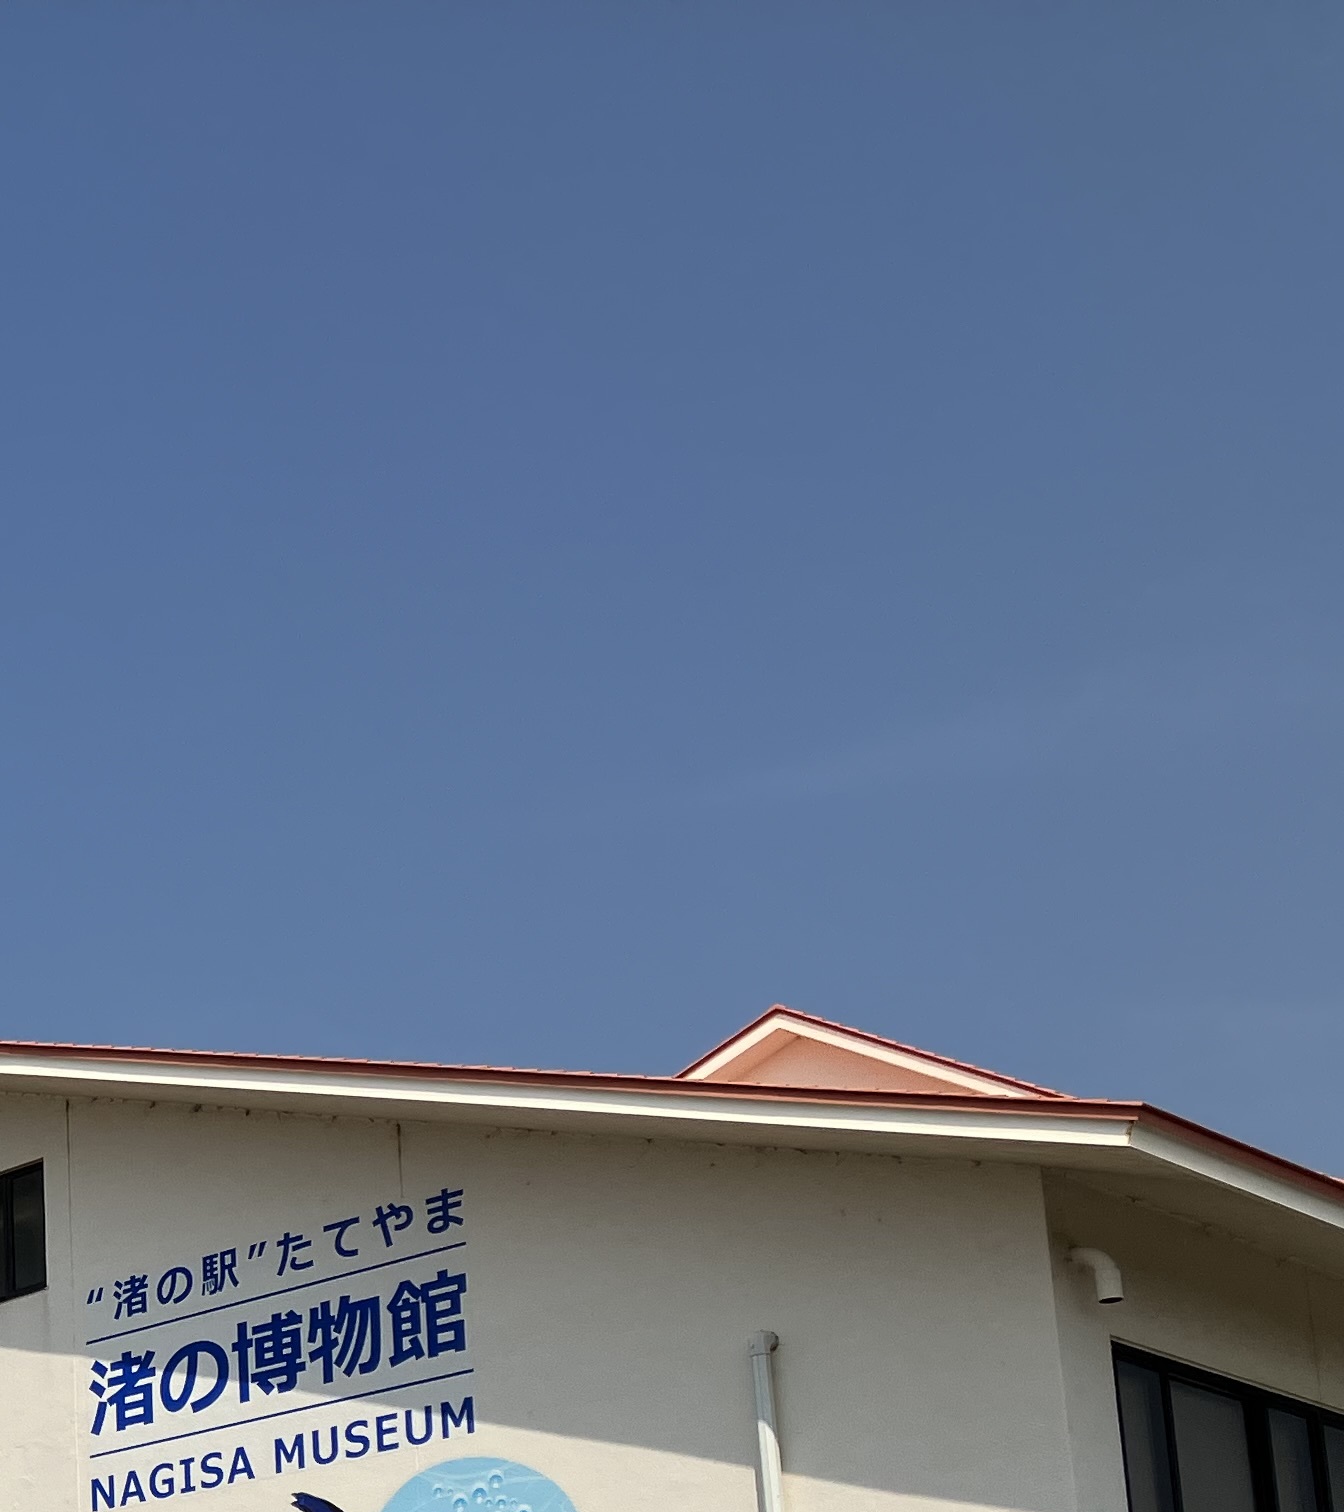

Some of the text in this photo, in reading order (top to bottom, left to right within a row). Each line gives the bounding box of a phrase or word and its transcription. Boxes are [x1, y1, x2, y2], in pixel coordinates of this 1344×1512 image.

[89, 1269, 467, 1436] 渚の博物館
[91, 1396, 475, 1512] NAGISA MUSEUM
